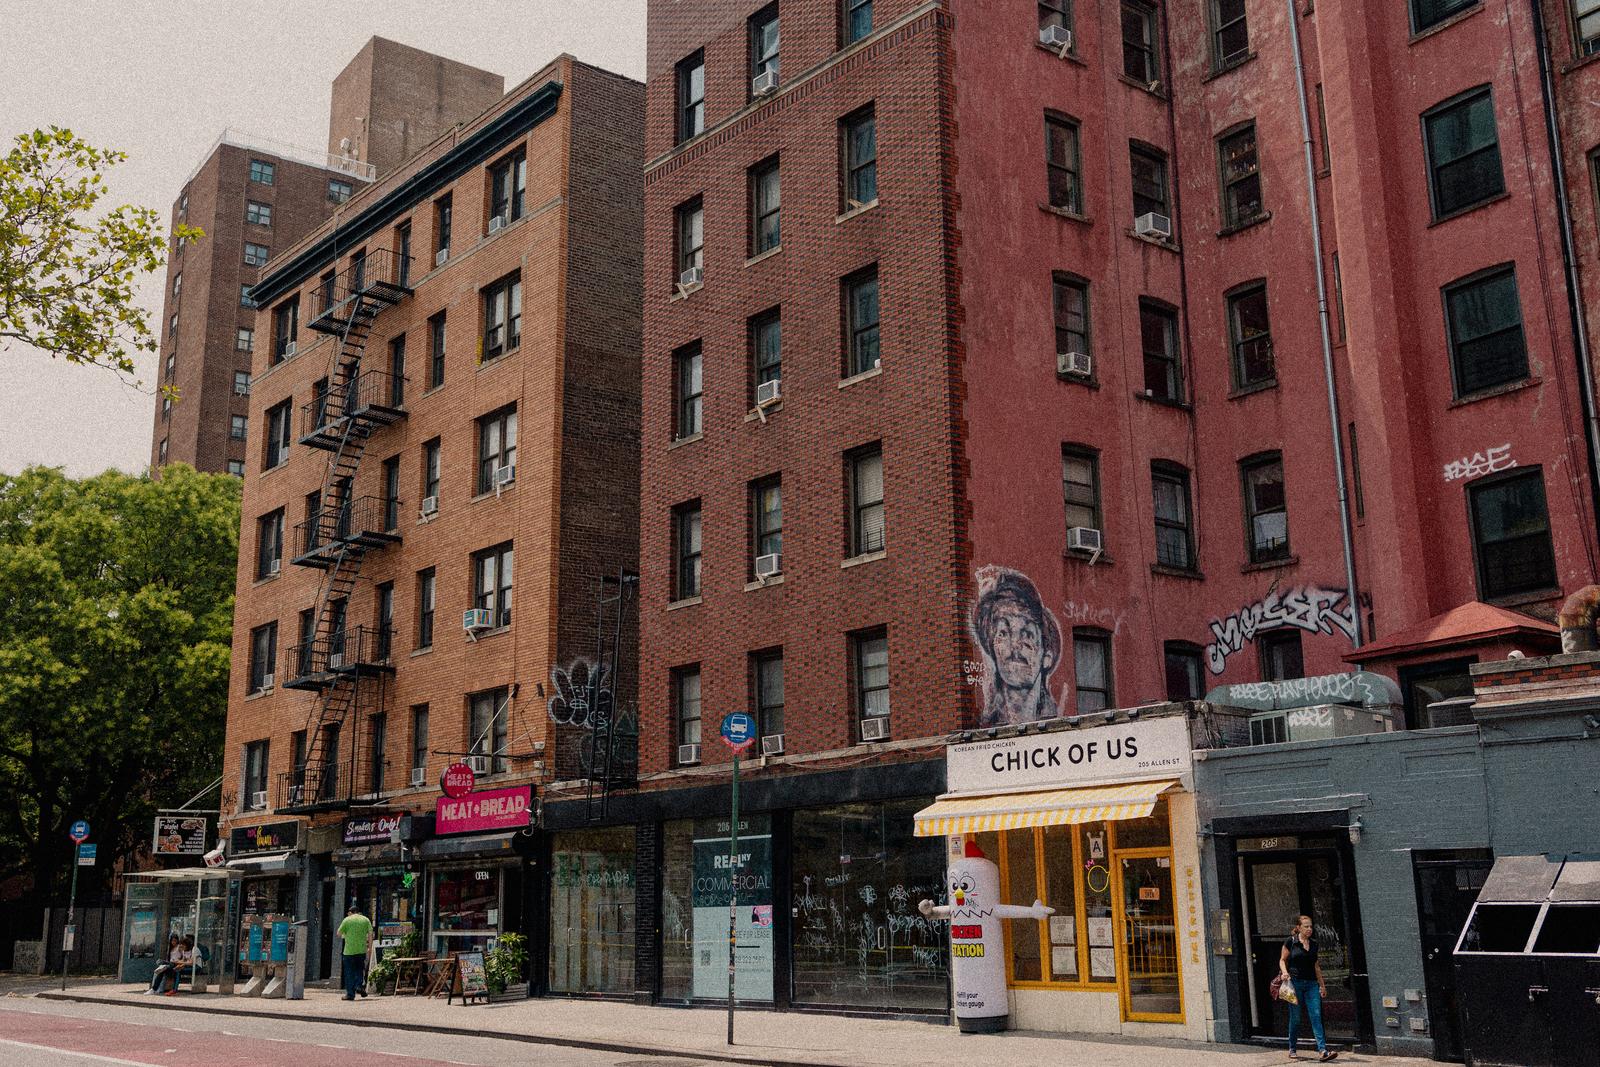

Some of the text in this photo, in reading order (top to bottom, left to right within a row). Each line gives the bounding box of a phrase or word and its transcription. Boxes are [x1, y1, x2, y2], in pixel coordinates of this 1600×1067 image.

[992, 741, 1016, 749] CHICKEN
[991, 736, 1138, 773] CHICK OF US
[441, 795, 525, 822] MEAT BREAD
[1093, 840, 1101, 853] A
[1262, 838, 1277, 848] 205
[475, 871, 489, 881] OPEN
[697, 875, 771, 892] COMMERCIAL
[966, 992, 979, 1000] your
